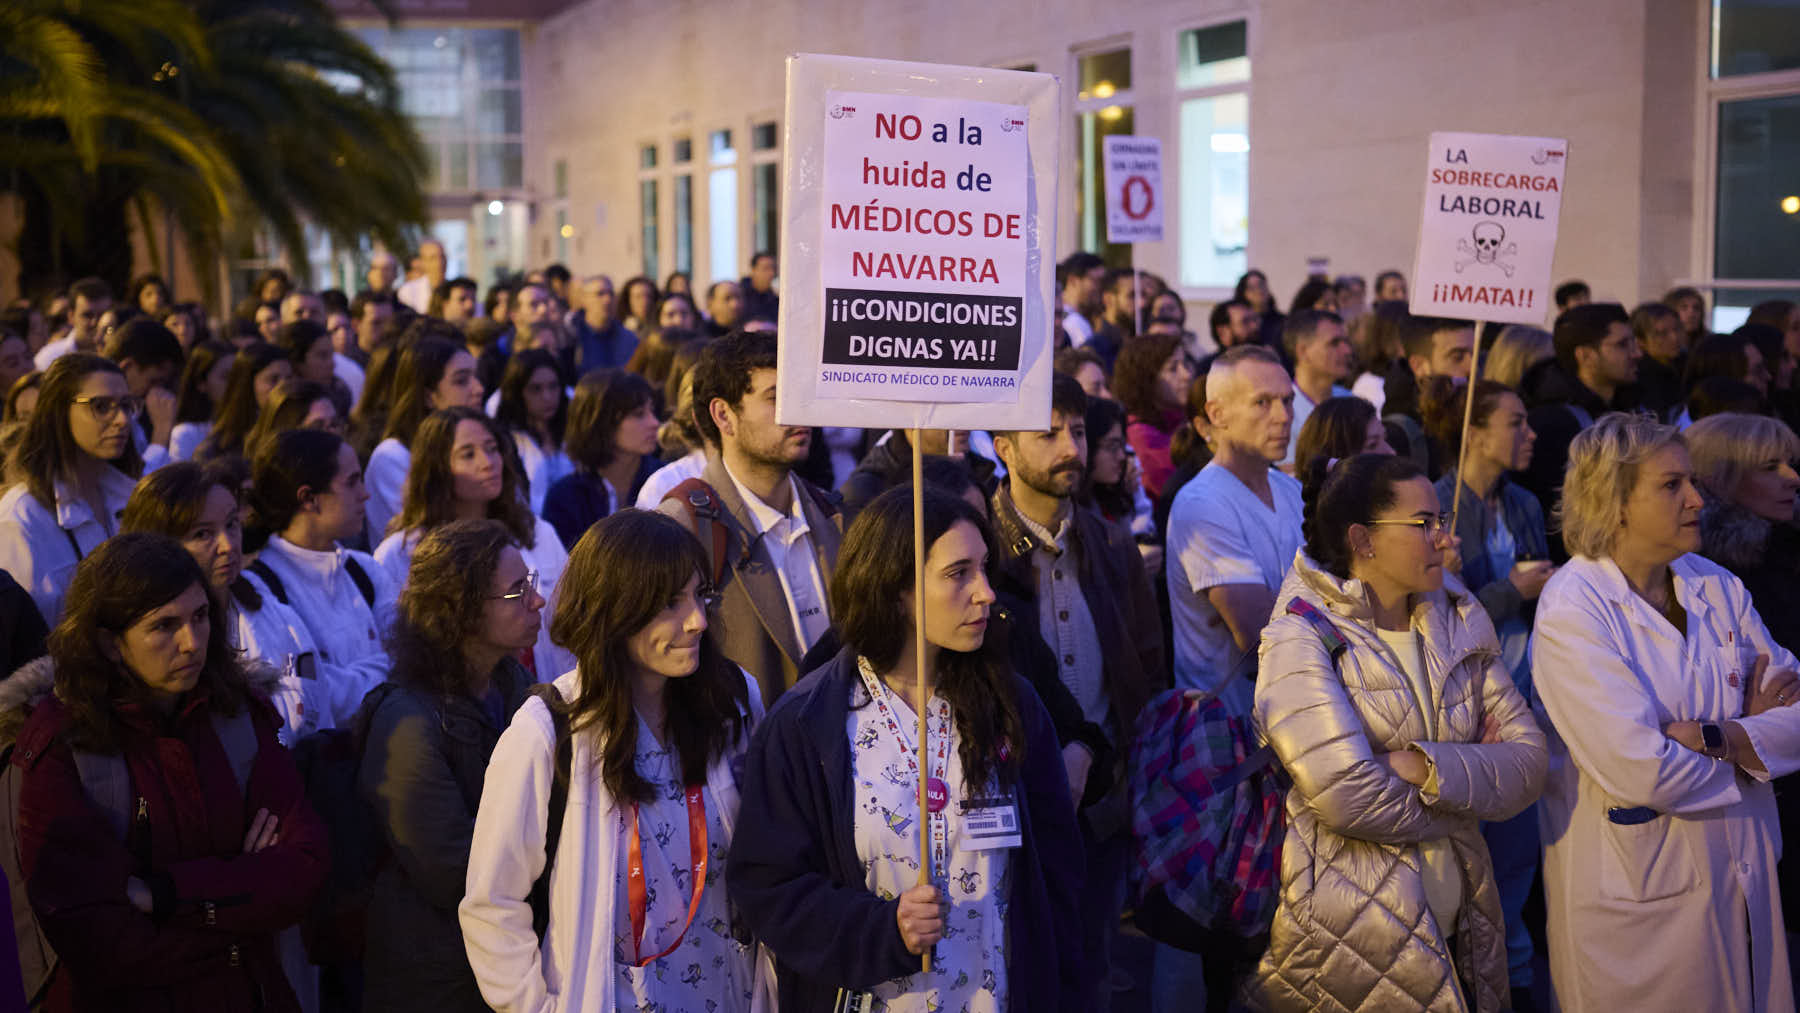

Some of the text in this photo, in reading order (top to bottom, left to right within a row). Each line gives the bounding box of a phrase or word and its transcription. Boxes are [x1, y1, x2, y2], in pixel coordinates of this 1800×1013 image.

[875, 112, 982, 146] NO a la
[1446, 148, 1469, 165] LA
[862, 156, 992, 193] huida de
[1431, 168, 1559, 193] SOBRECARGA
[830, 198, 1021, 240] MÉDICOS DE
[1439, 194, 1545, 220] LABORAL
[852, 251, 1000, 285] NAVARRA
[1433, 283, 1534, 308] ¡¡MATA!!
[832, 298, 1017, 327] ¡¡CONDICIONES
[848, 335, 997, 362] DIGNAS YA!!
[821, 370, 1016, 388] SINDICATO MÉDICO DE NAVARRA
